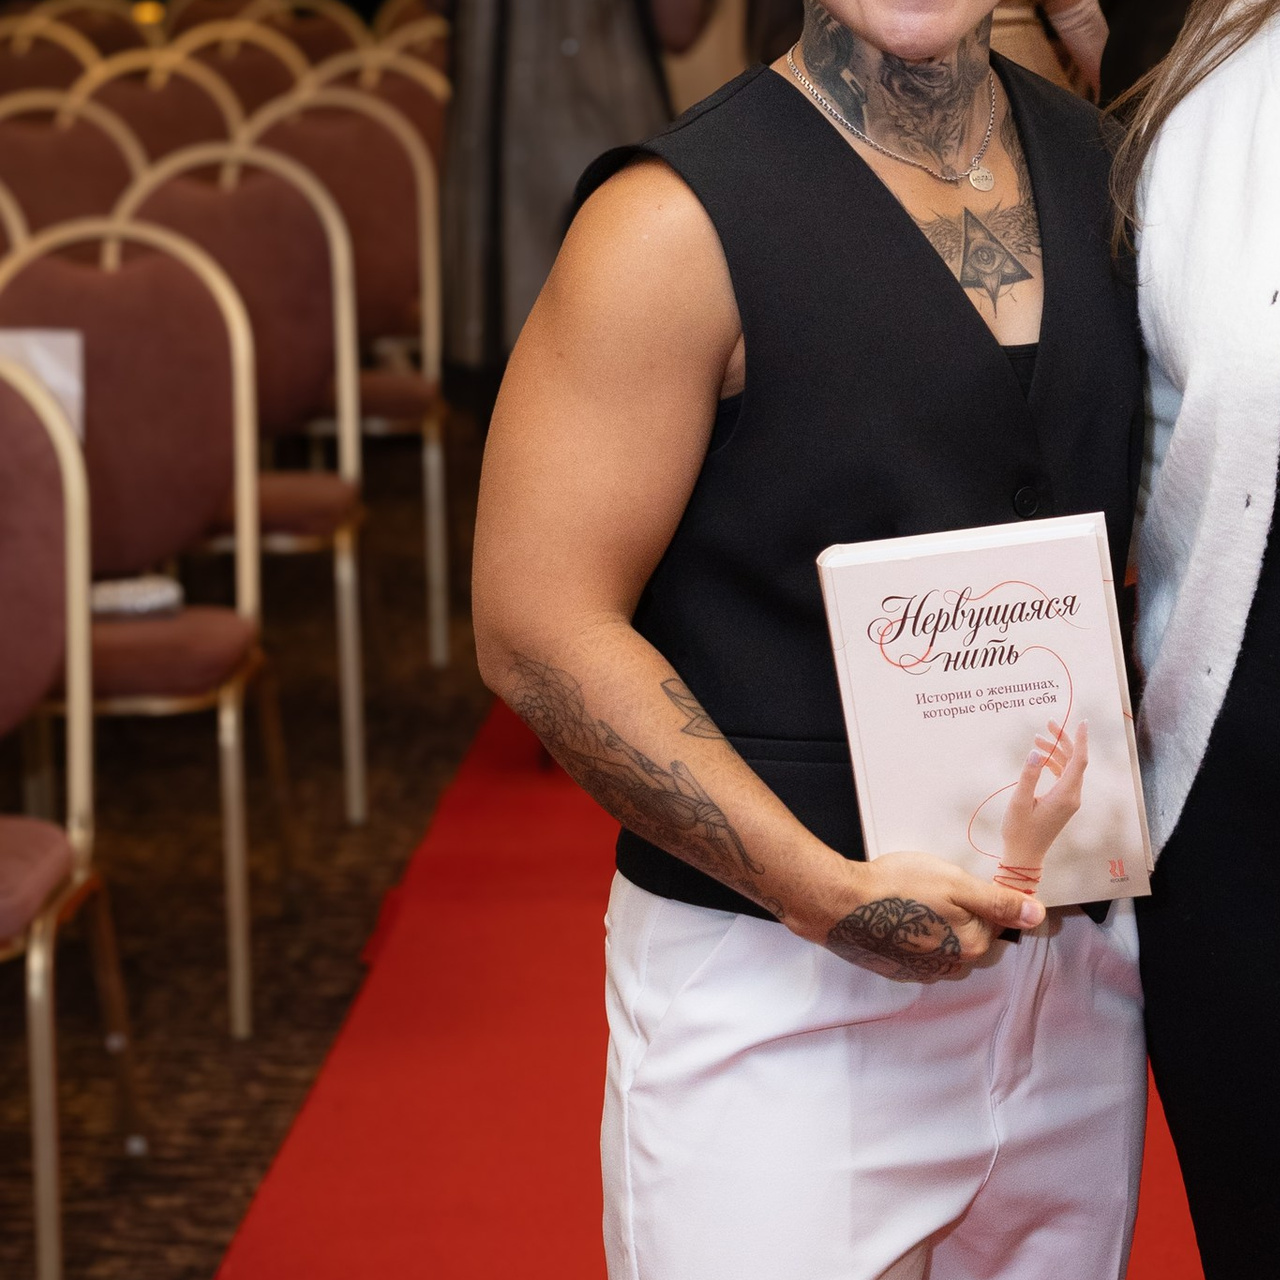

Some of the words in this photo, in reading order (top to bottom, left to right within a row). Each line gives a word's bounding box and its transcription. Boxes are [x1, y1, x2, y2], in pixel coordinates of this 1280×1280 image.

[867, 586, 1082, 647] Нервущаяся
[899, 637, 1020, 675] нить
[915, 689, 972, 705] Истории
[975, 688, 984, 697] о
[987, 679, 1060, 697] женщинах,
[922, 704, 976, 719] которые
[979, 698, 1025, 714] обрели
[1028, 692, 1057, 708] себя
